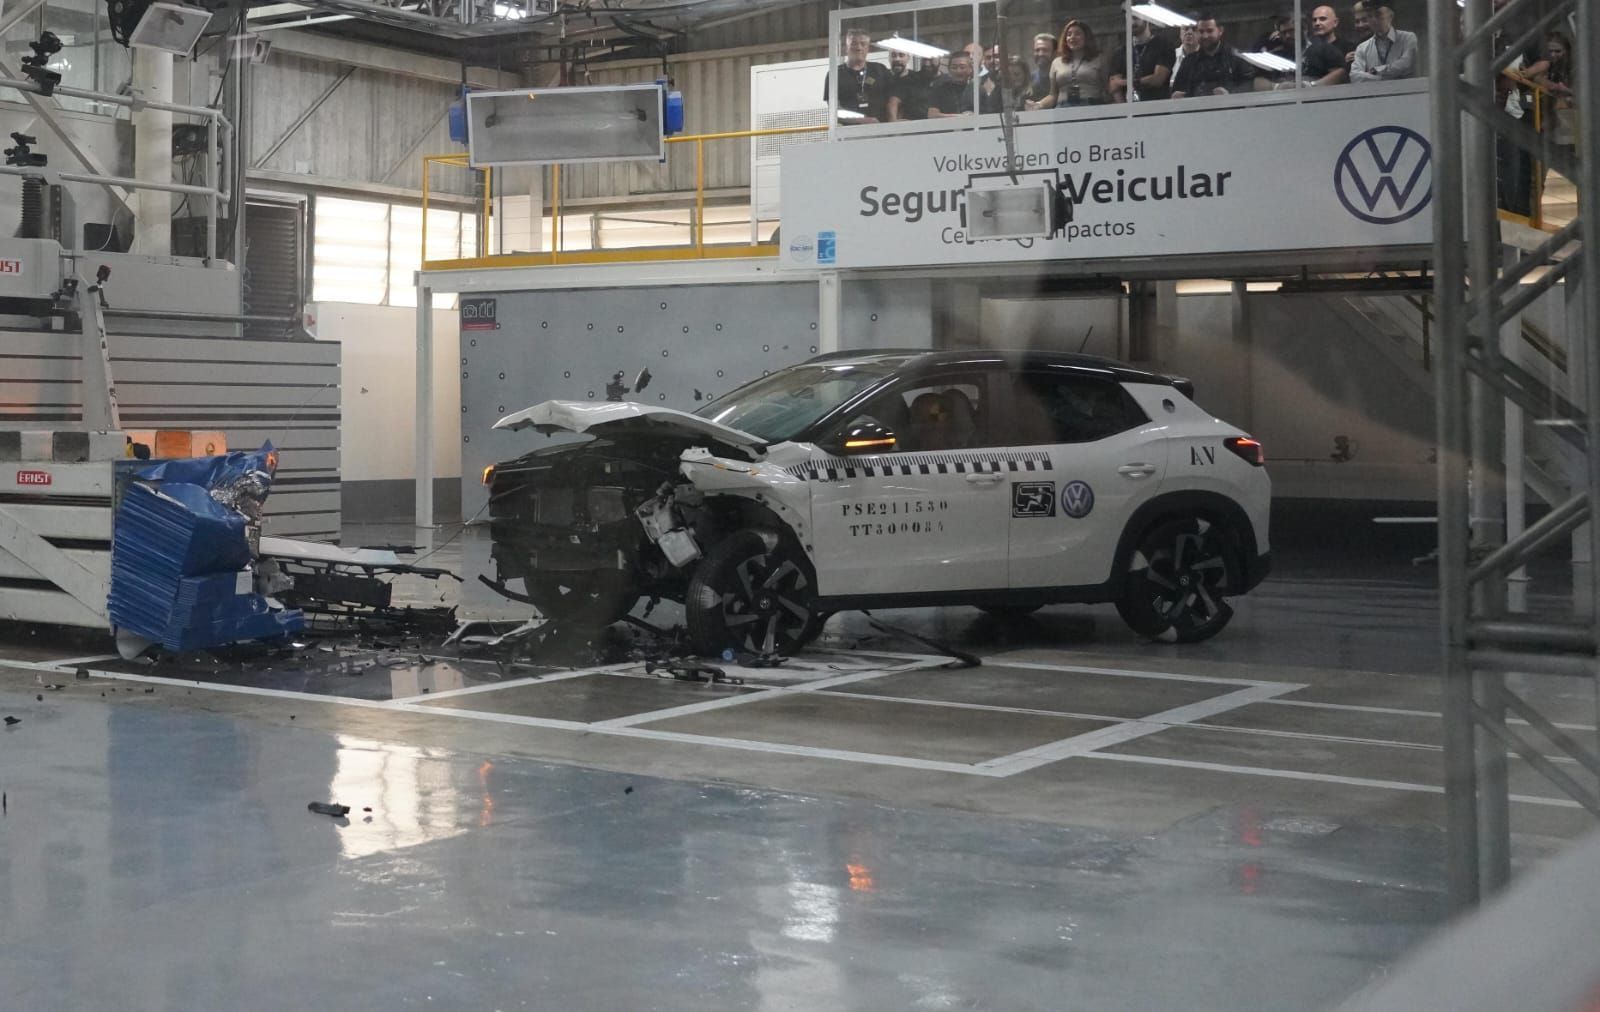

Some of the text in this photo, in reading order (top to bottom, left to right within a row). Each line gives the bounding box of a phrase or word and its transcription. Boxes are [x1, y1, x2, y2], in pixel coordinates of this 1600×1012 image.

[934, 141, 1146, 173] Volkswagen do Brasil
[860, 165, 1232, 222] Segur Veicular
